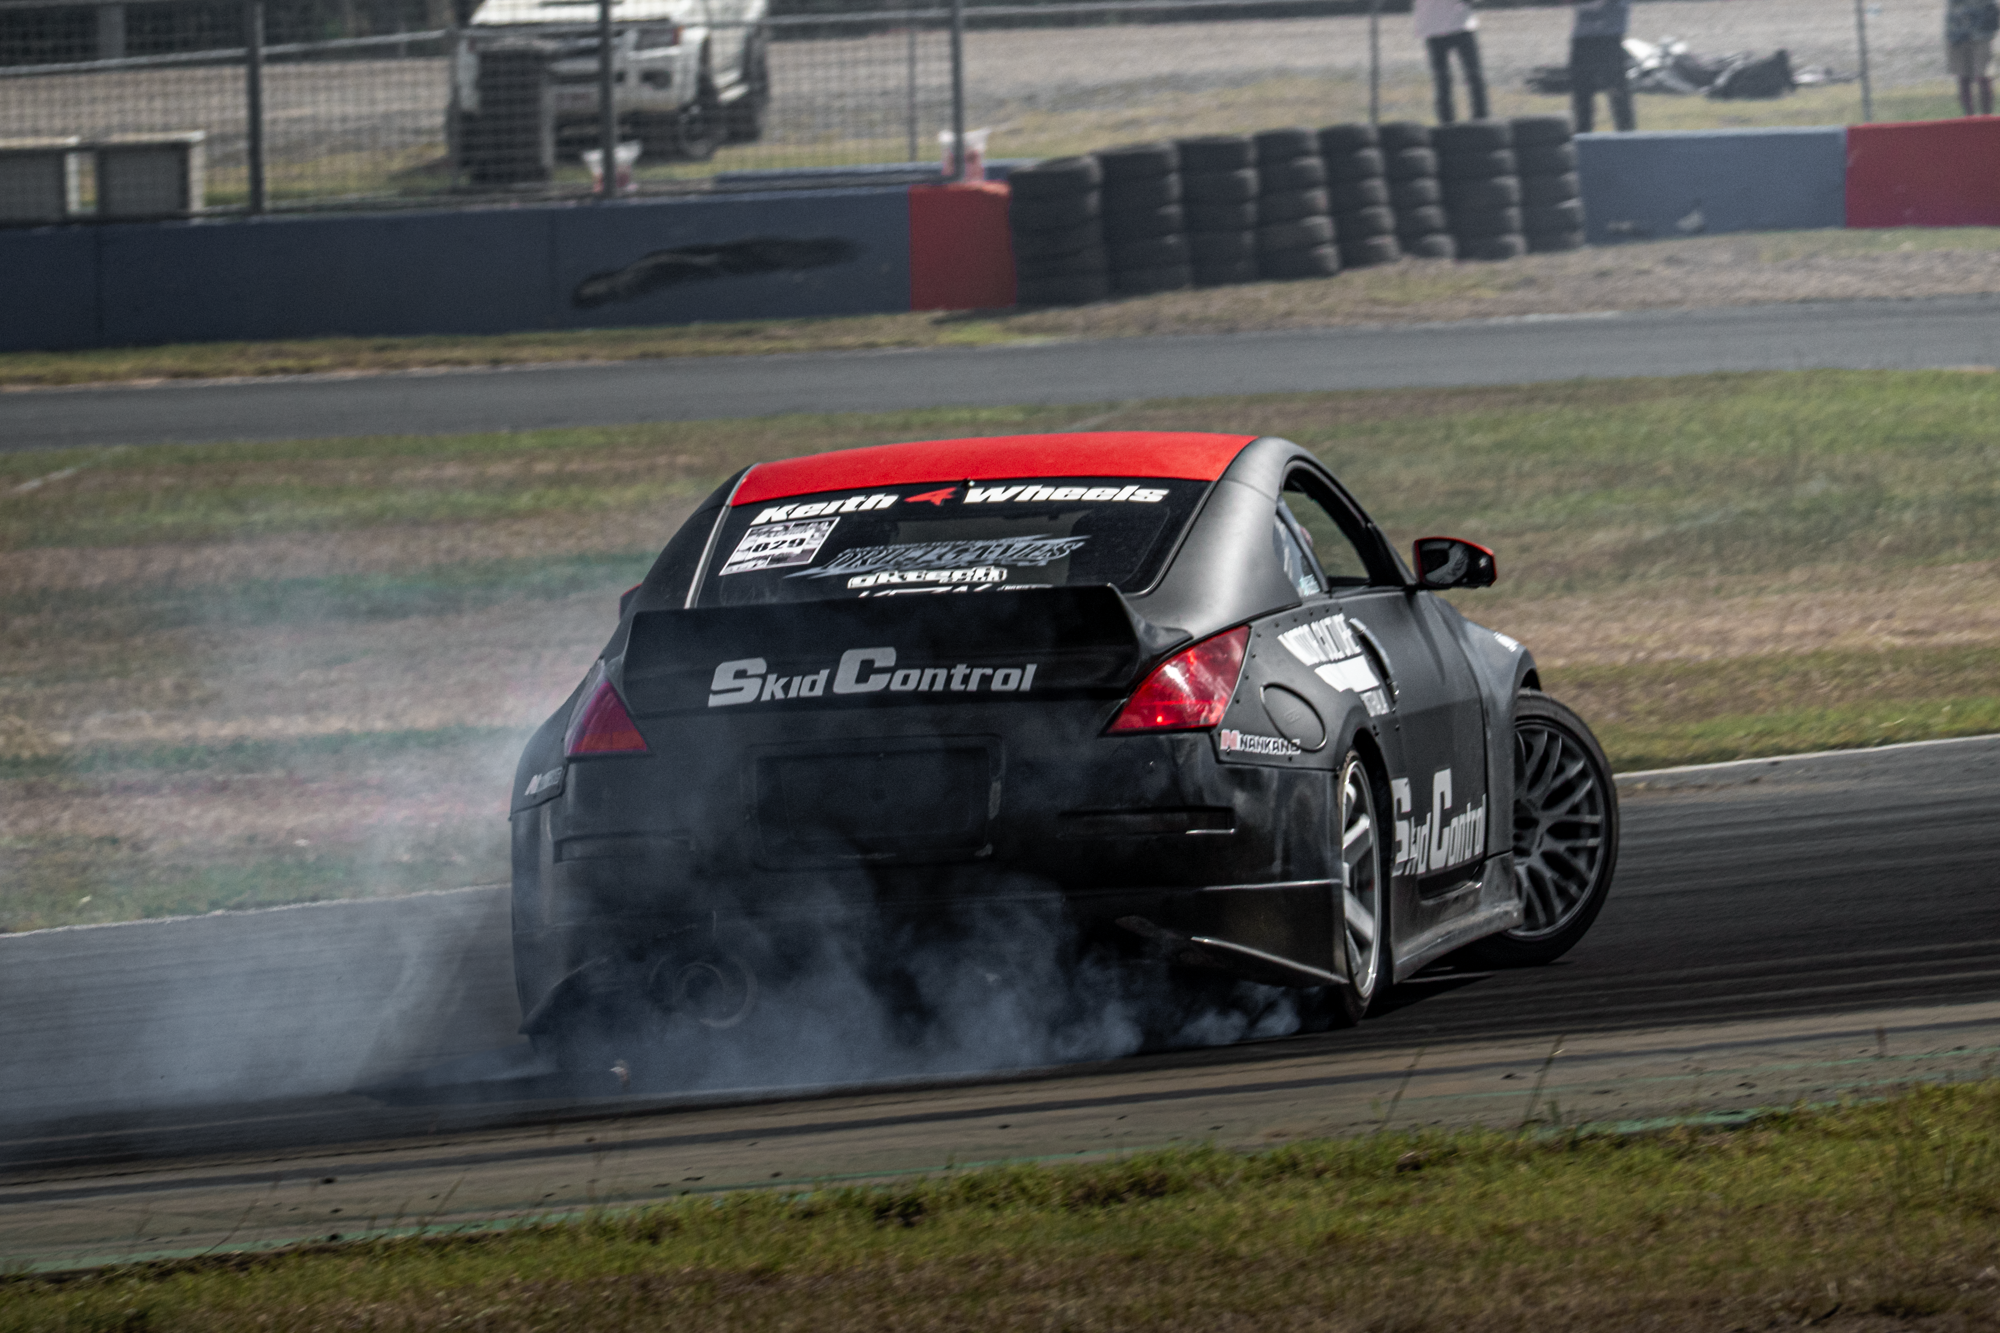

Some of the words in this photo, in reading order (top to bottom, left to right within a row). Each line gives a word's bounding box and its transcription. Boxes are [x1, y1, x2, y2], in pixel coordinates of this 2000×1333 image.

[750, 493, 899, 526] Keith
[963, 484, 1170, 504] Wheels
[708, 657, 830, 707] Skid
[833, 647, 1037, 694] Control
[1391, 777, 1431, 877] Skid
[1431, 767, 1487, 871] Control
